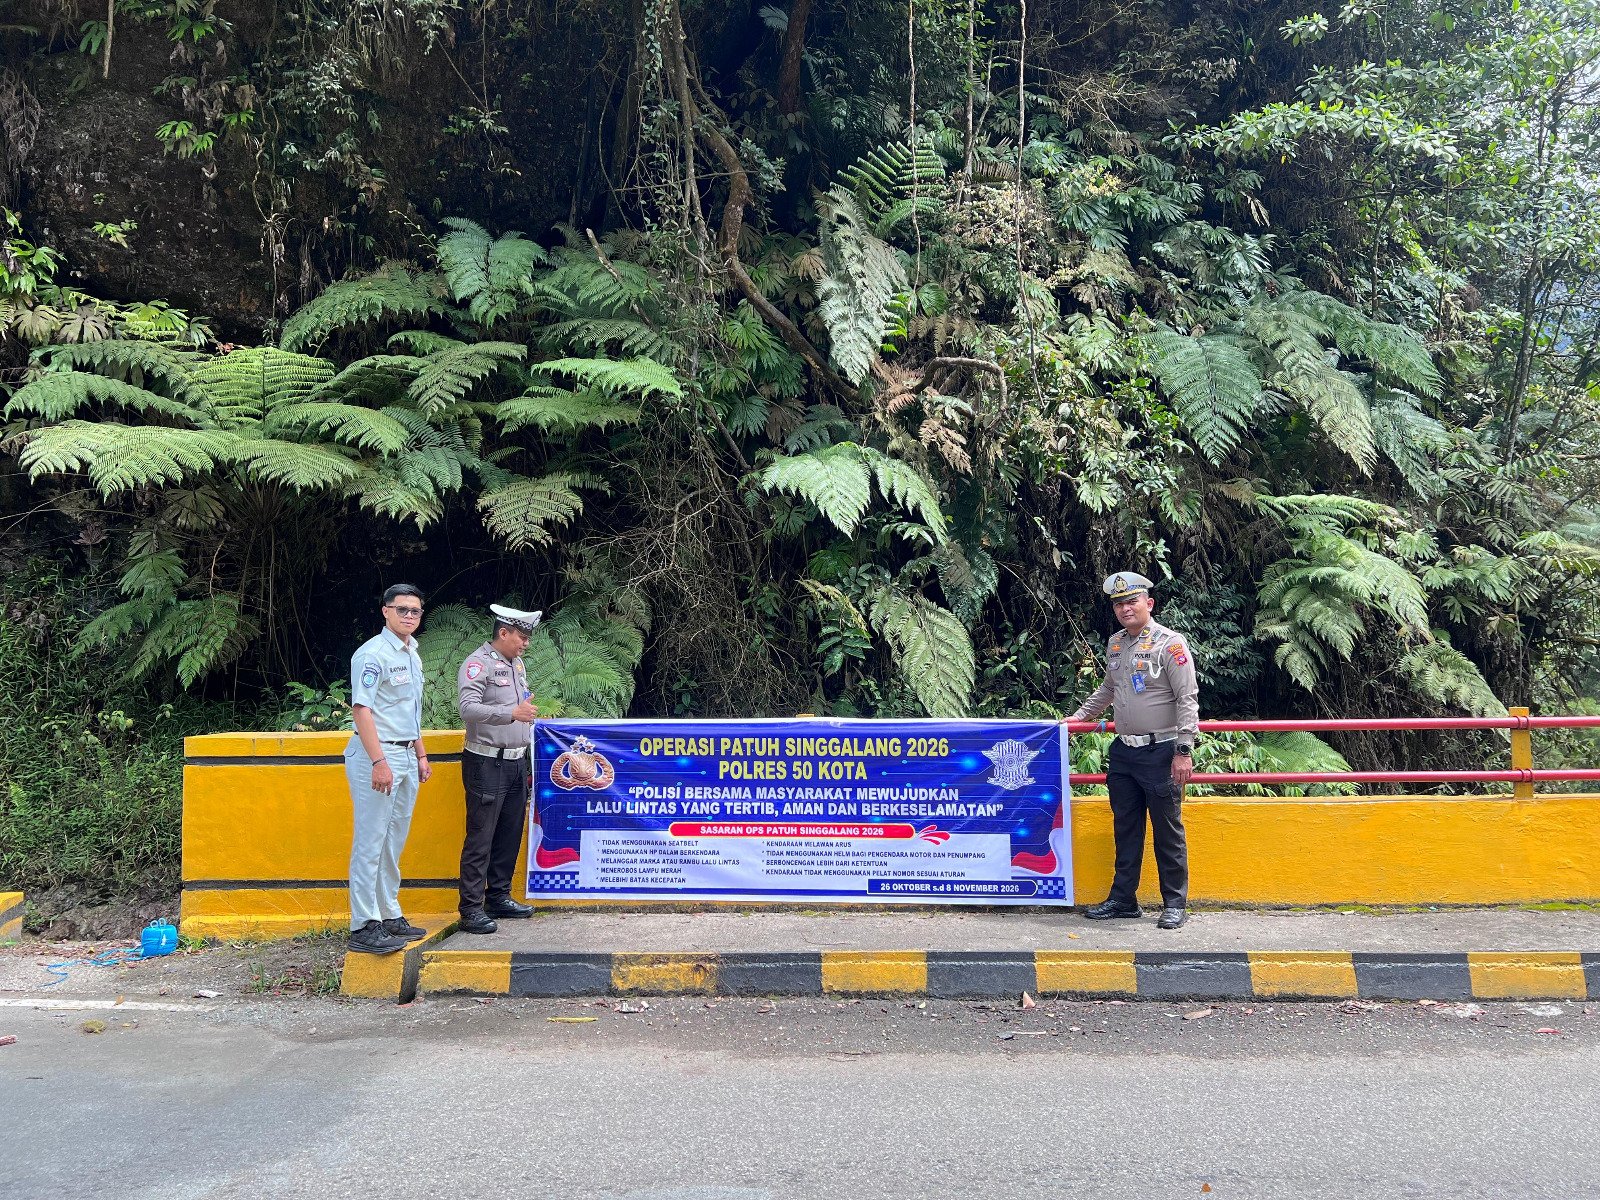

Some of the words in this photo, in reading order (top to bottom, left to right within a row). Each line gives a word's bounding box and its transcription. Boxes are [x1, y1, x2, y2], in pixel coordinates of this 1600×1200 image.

[639, 737, 714, 756] OPERASI
[720, 738, 780, 756] PATUH
[785, 738, 902, 757] SINGGALANG
[906, 738, 949, 757] 2026
[718, 760, 787, 780] POLRES
[792, 761, 813, 780] 50
[818, 762, 868, 780] KOTA
[684, 787, 752, 800] BERSAMA
[756, 787, 852, 800] MASYARAKAT
[856, 788, 959, 801] MEWUJUDKAN
[586, 802, 622, 814] LALU
[626, 802, 677, 814] LINTAS
[681, 802, 720, 814] YANG
[724, 803, 779, 818] TERTIB,
[782, 803, 824, 815] AMAN
[828, 804, 858, 816] DAN
[700, 826, 744, 834] SASARAN
[766, 826, 797, 834] PATUH
[800, 826, 860, 835] SINGGALANG
[862, 828, 884, 836] 2026
[880, 882, 890, 890] 26
[892, 883, 930, 891] OKTOBER
